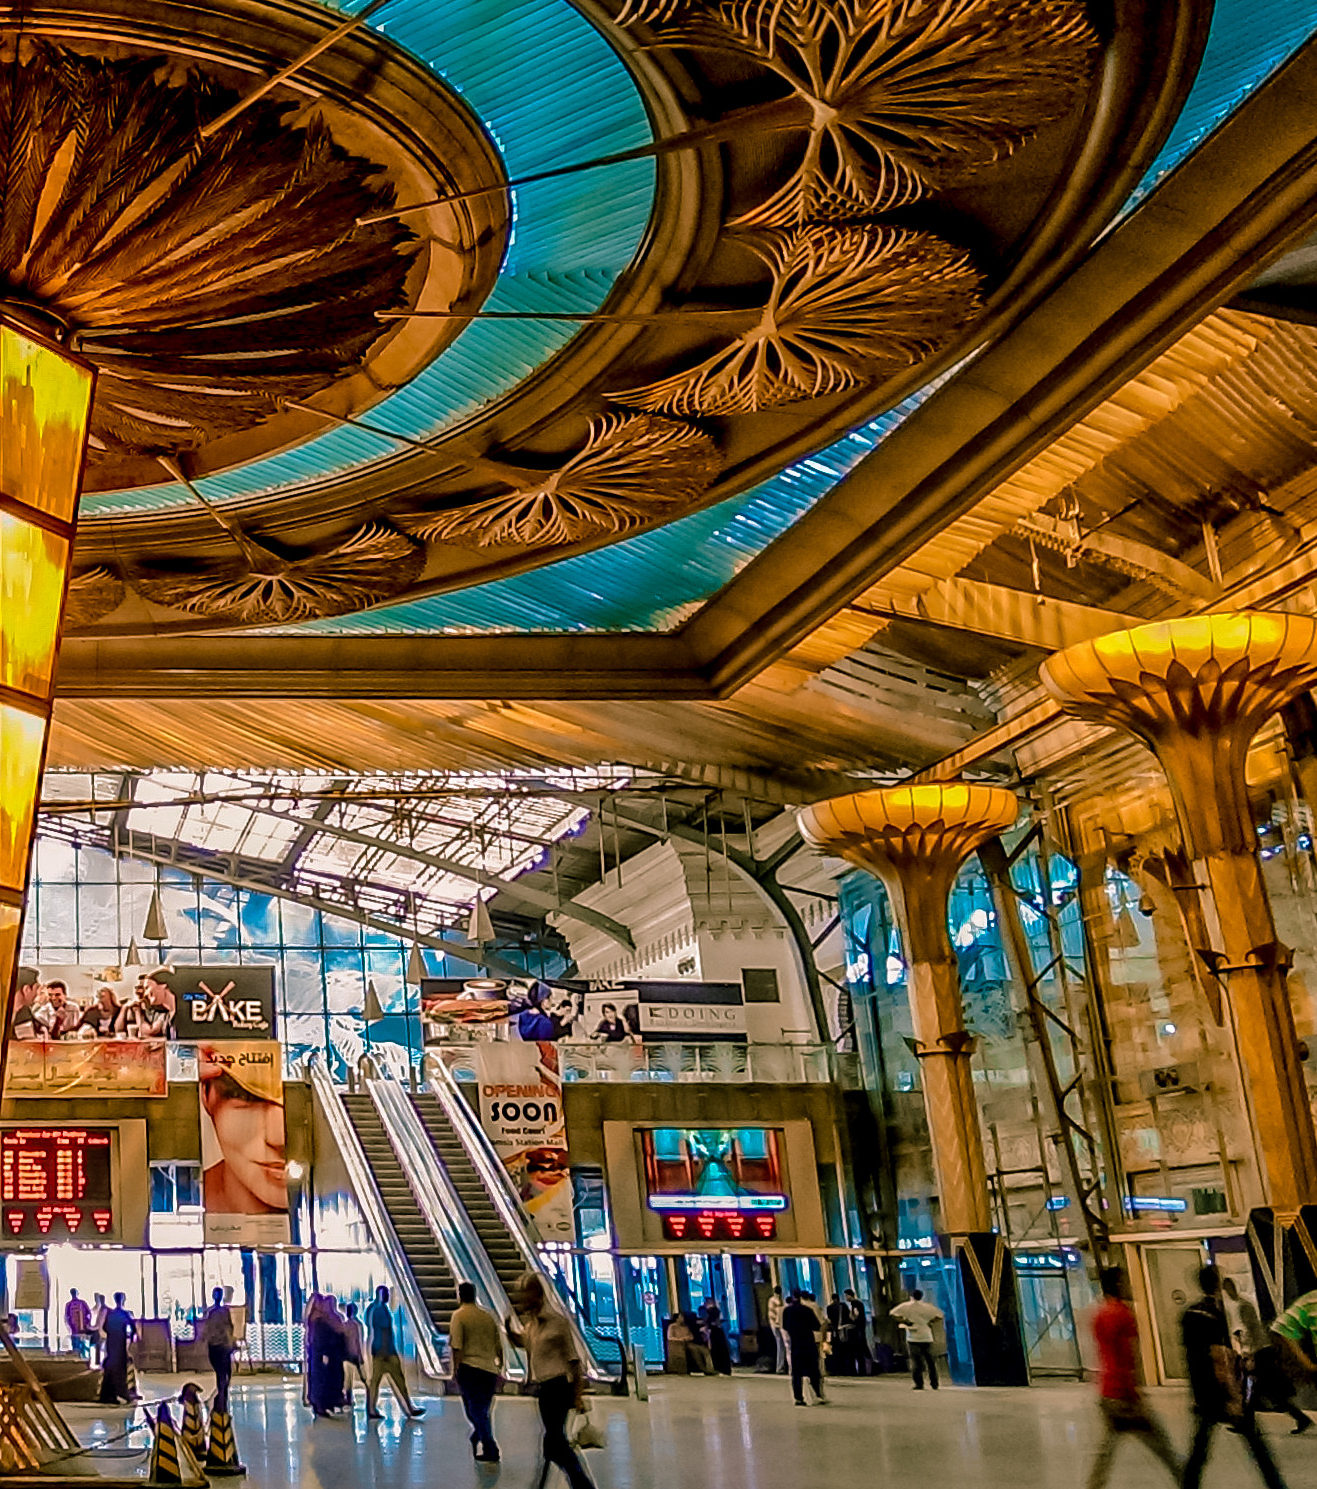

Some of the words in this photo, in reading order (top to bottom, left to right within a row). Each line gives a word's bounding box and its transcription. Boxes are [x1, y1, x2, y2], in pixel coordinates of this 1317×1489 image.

[192, 996, 263, 1022] BAKE
[483, 1084, 559, 1098] OPENING
[491, 1102, 558, 1122] SOON
